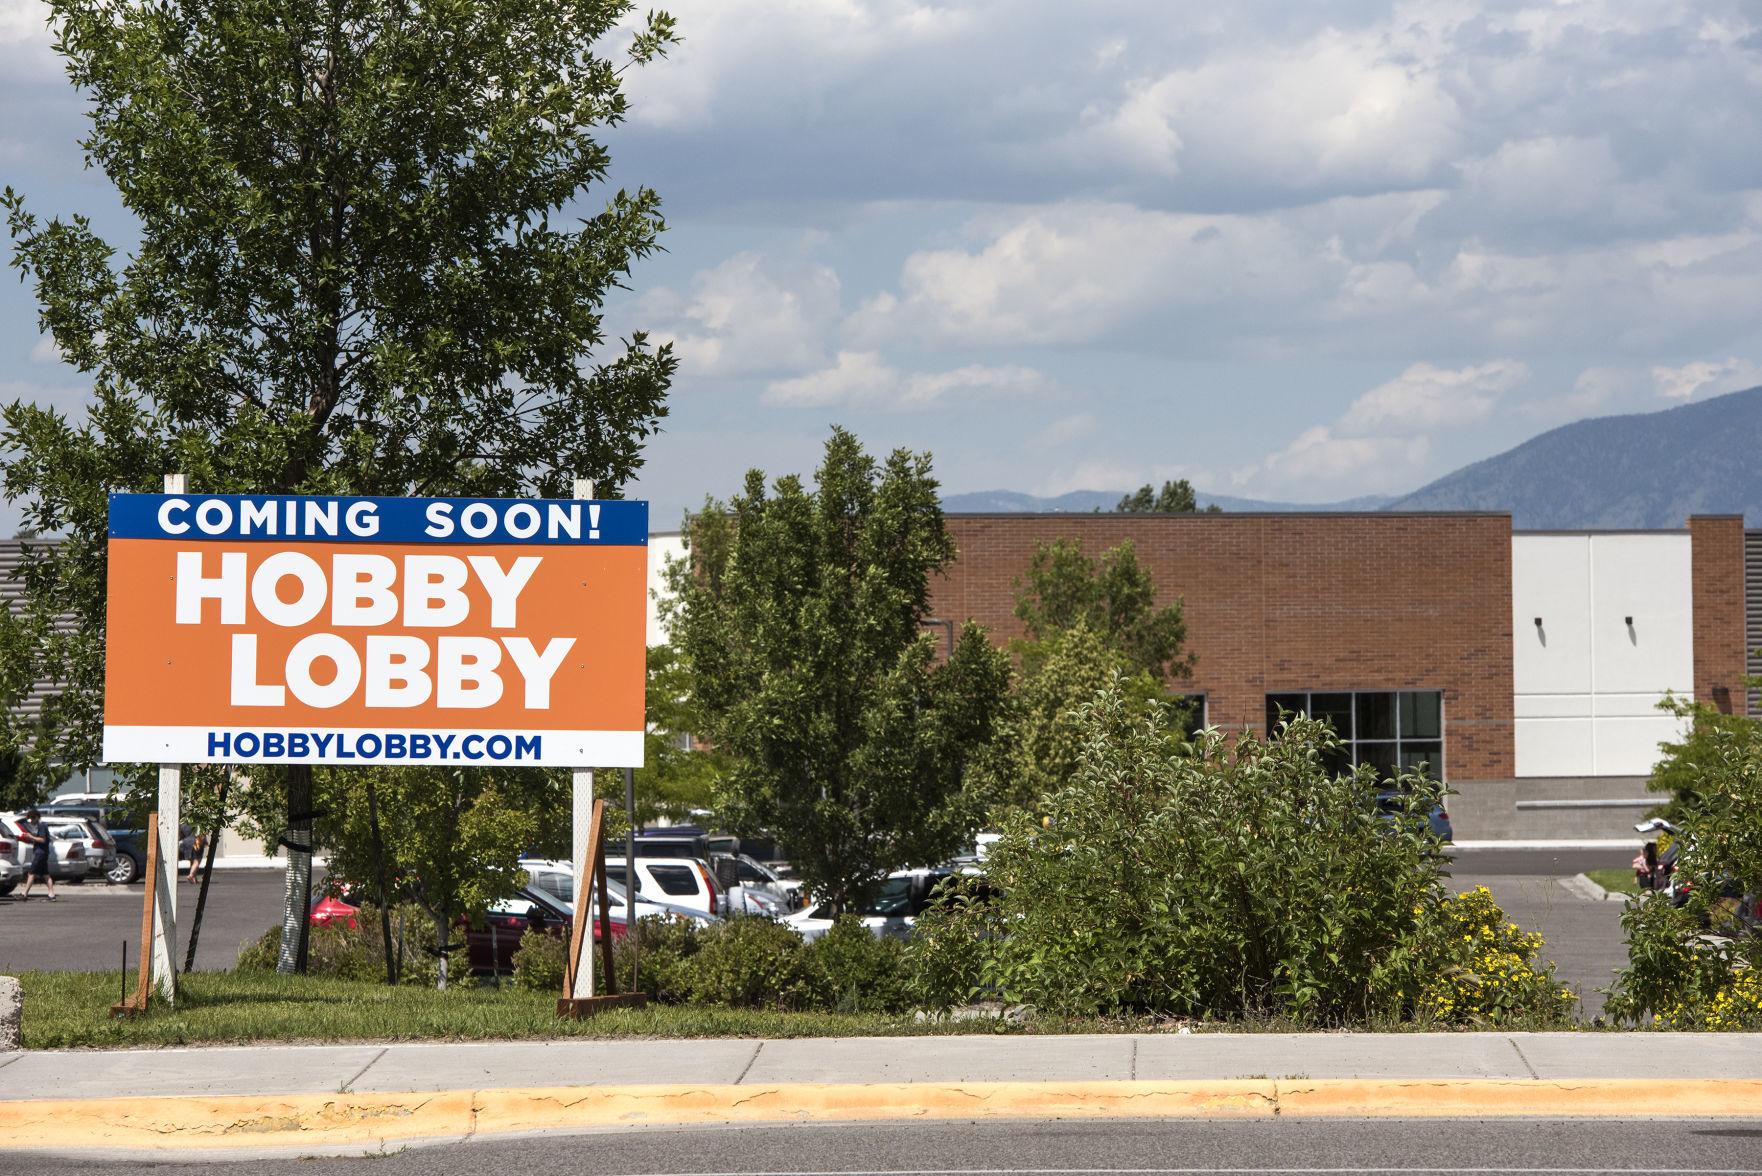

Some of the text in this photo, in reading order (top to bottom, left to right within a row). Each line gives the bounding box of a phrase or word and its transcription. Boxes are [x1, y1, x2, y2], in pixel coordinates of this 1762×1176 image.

[157, 498, 601, 540] COMING SOON!
[175, 550, 544, 628] HOBBY
[230, 632, 577, 710] LOBBY
[207, 731, 543, 760] HOBBYLOBBY.COM
